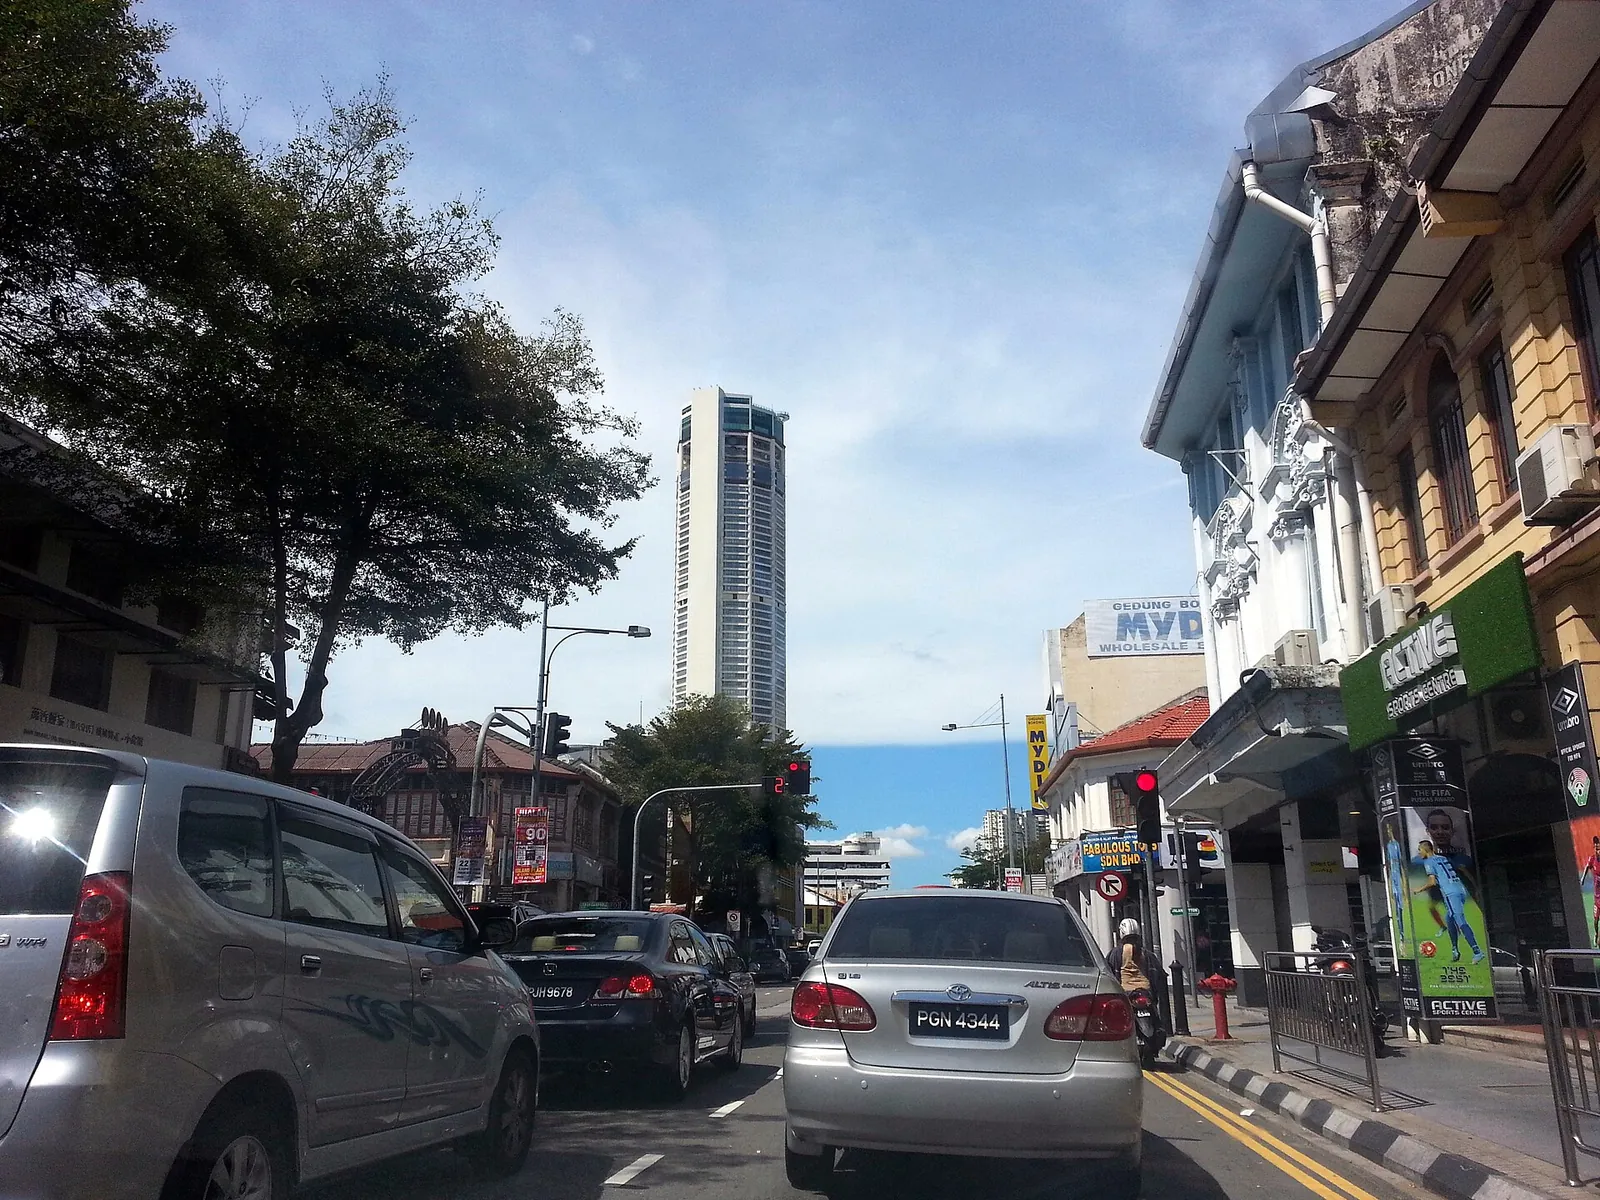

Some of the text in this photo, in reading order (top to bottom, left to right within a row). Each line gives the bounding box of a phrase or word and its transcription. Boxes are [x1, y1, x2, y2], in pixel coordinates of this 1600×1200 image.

[1112, 601, 1171, 611] GEDUNG
[1099, 642, 1188, 652] WHOLESALE
[1379, 612, 1458, 691] ACTIVE
[1386, 665, 1467, 720] SPORTS CENTRE
[1557, 715, 1580, 732] umbro
[1411, 760, 1445, 768] umbro
[775, 777, 784, 793] 2
[1414, 789, 1452, 797] THE FIFA
[1083, 841, 1158, 855] FABULOUS TOS
[1100, 854, 1140, 867] SDN BHD
[1024, 981, 1060, 989] ALTIS
[547, 986, 573, 998] 9678
[1431, 1000, 1487, 1010] ACTIVE
[917, 1010, 1000, 1030] PGN 4344
